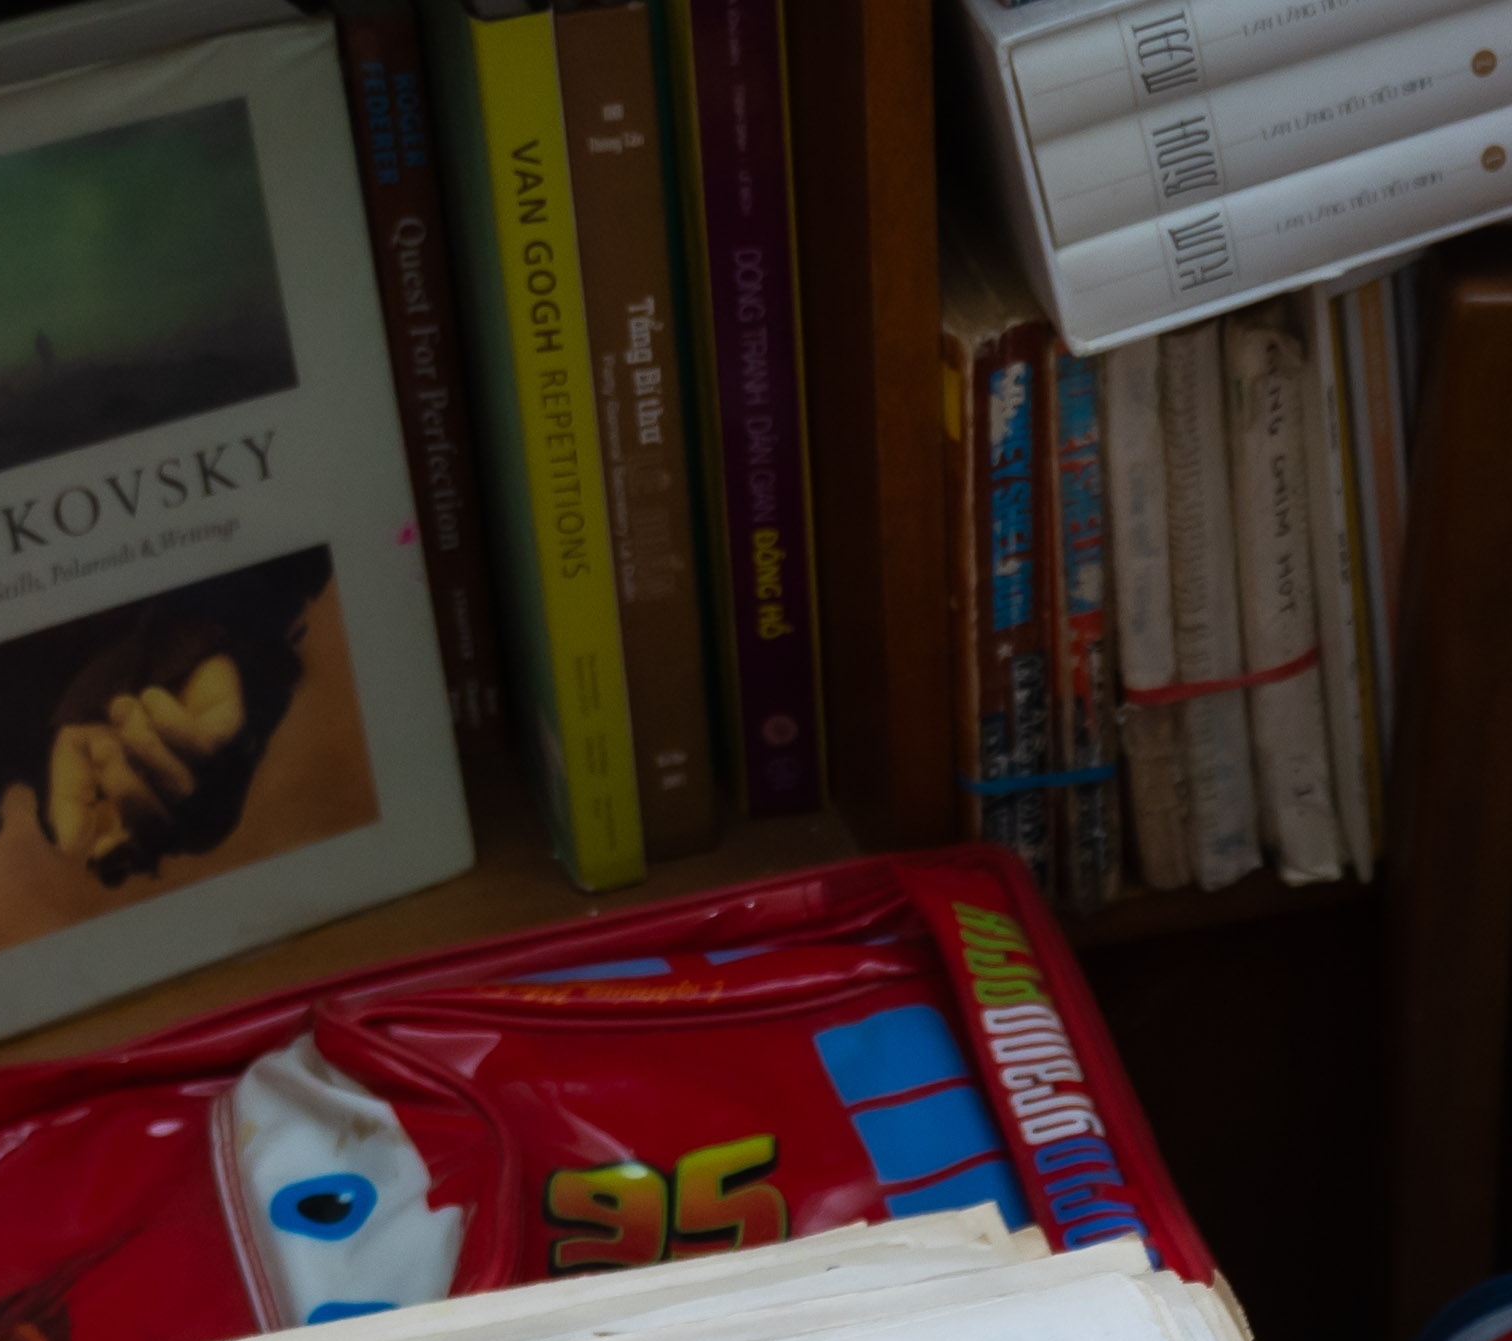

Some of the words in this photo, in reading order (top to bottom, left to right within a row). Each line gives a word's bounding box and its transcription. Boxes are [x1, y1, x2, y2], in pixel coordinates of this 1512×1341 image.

[355, 57, 400, 185] FEDERER
[391, 71, 425, 170] ROGER
[510, 139, 548, 225] VAN
[389, 215, 432, 316] Quest
[523, 239, 564, 354] GOGH
[406, 323, 440, 380] For
[414, 386, 460, 552] Perfection
[538, 368, 592, 580] REPETITIONS
[541, 1136, 790, 1276] 95
